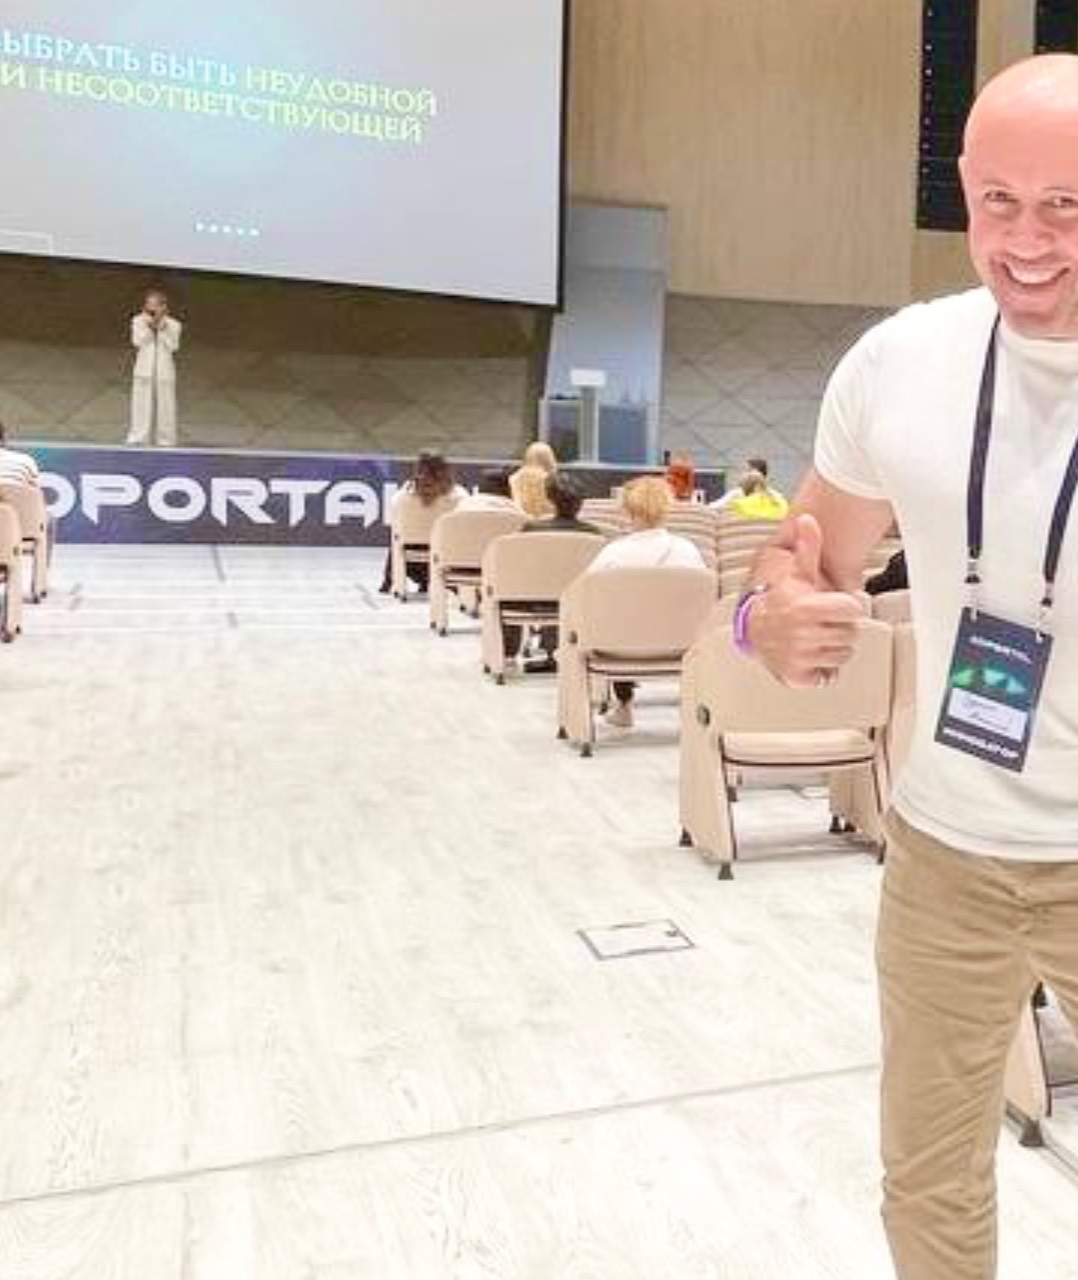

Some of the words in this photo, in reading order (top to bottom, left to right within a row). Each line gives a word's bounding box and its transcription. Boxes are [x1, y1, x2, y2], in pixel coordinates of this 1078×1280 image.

[0, 29, 140, 72] ЫБРАТЬ
[150, 50, 237, 87] БЫТЬ
[246, 64, 437, 117] НЕУДОБНОЙ
[39, 66, 422, 144] НЕСООТВЕТСТВУЮЩЕЙ
